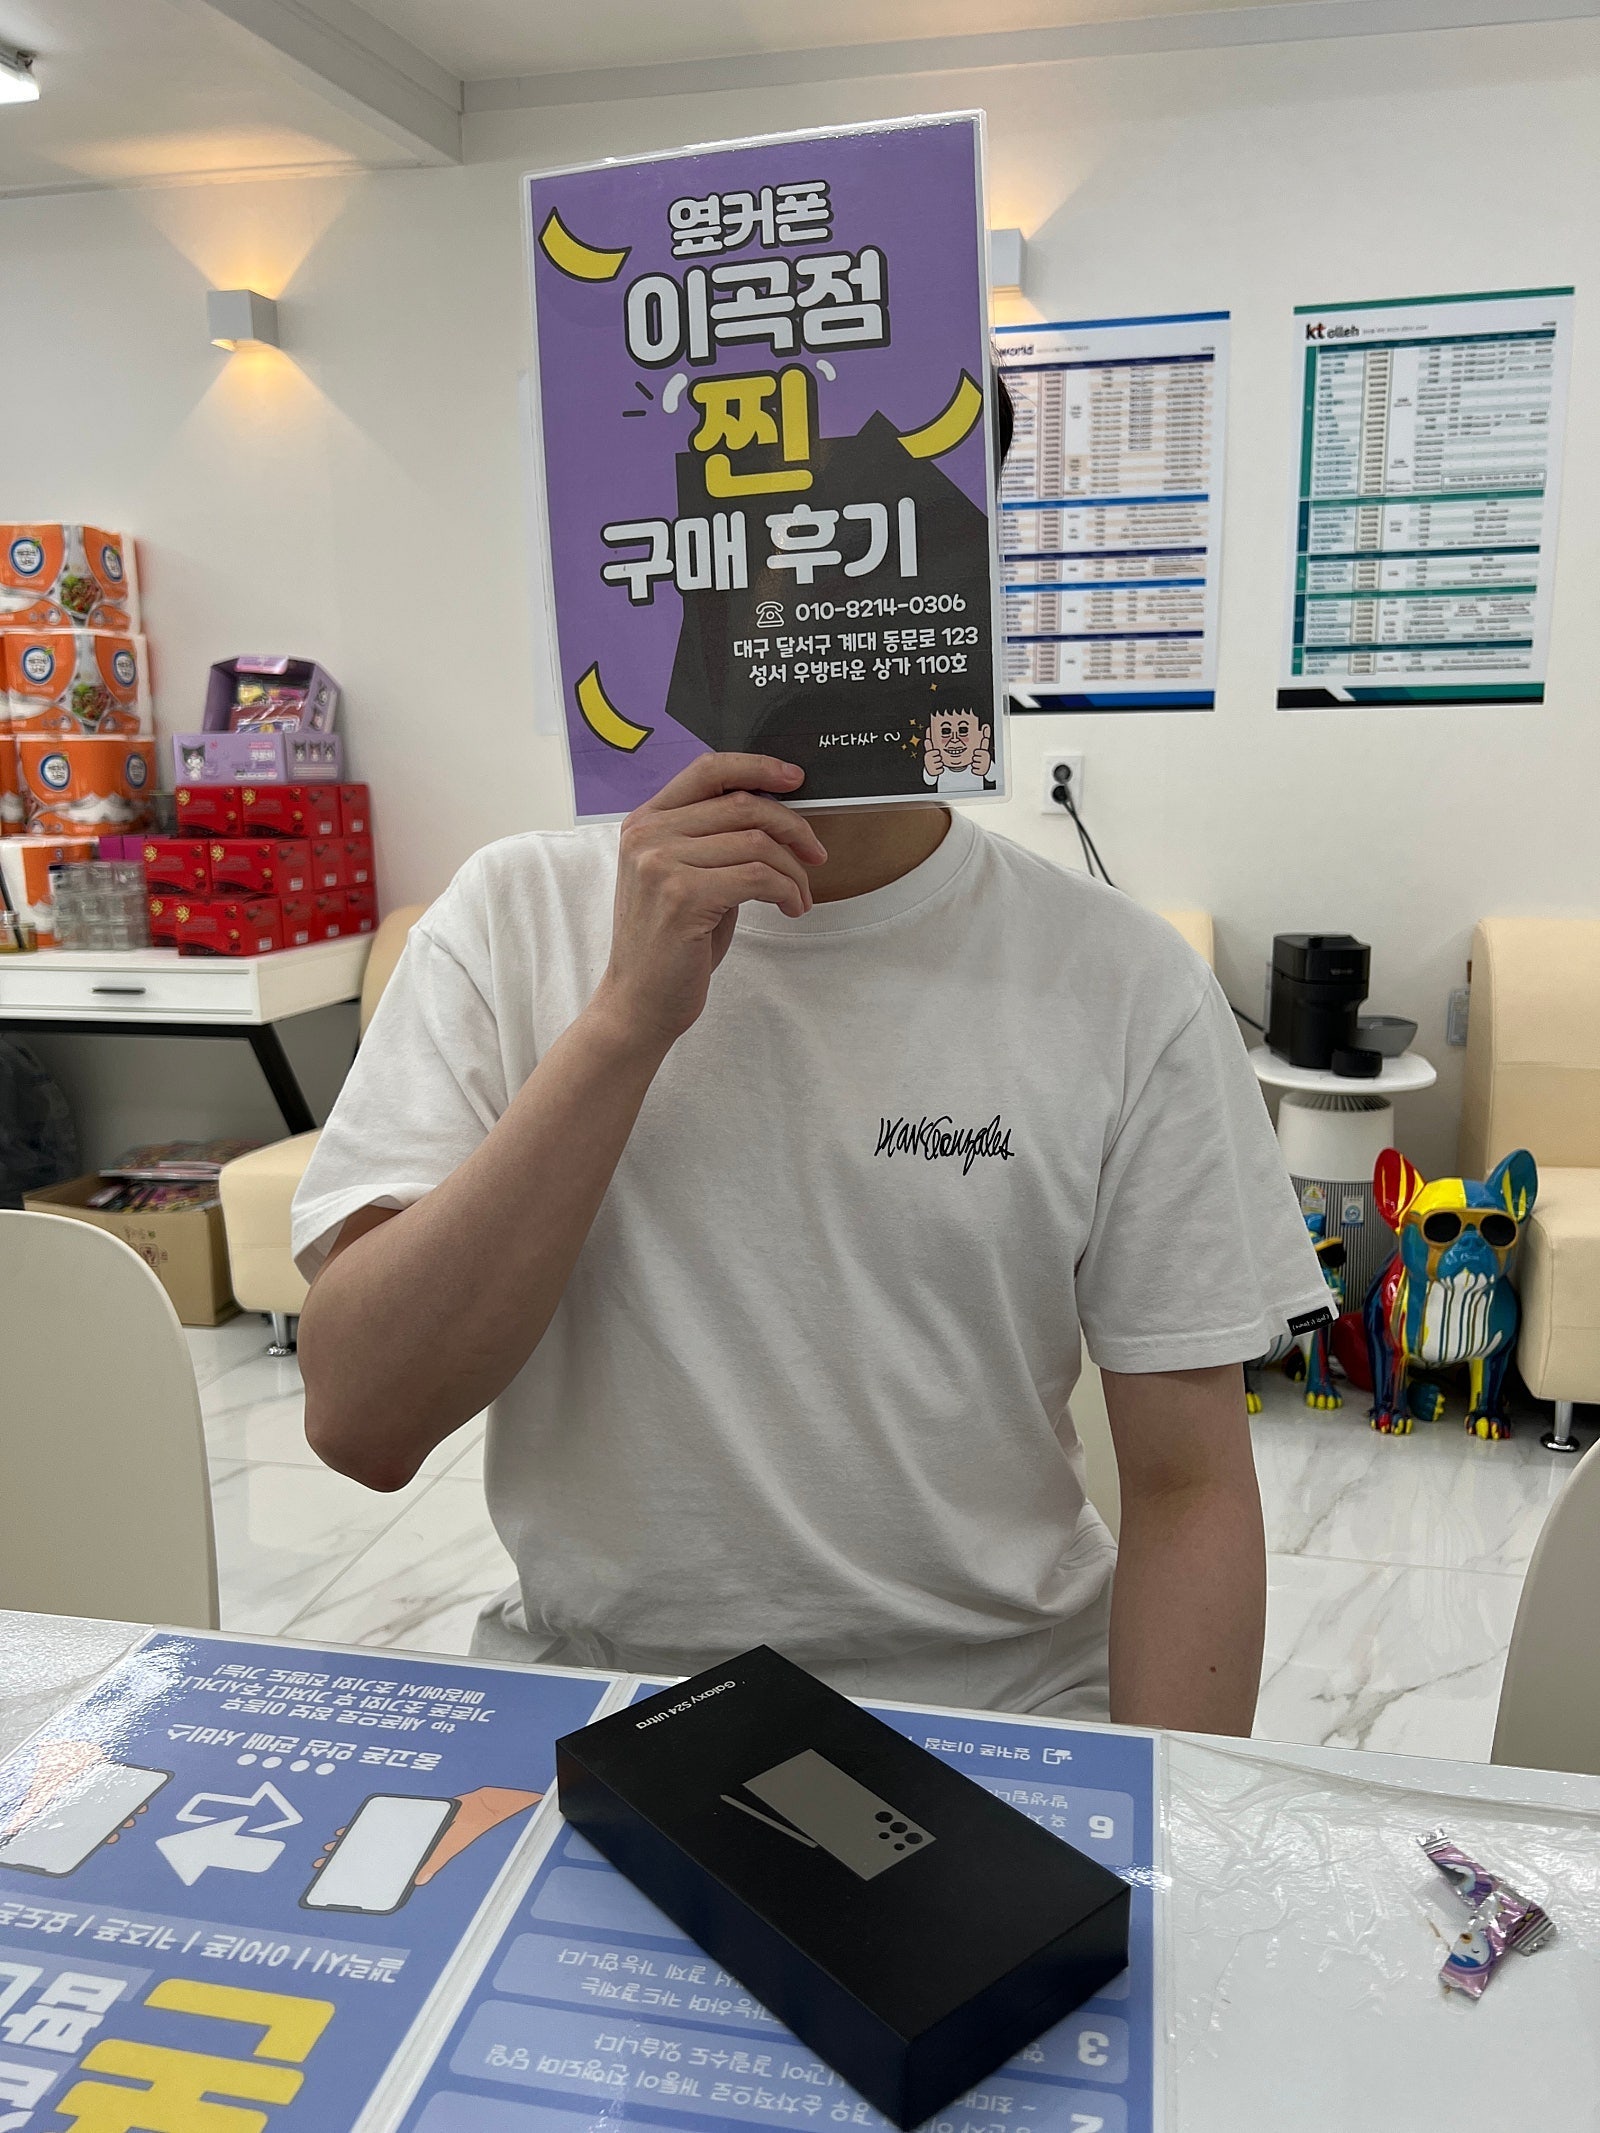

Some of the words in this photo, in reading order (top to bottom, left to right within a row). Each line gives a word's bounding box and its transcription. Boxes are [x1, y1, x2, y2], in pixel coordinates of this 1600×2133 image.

[669, 181, 830, 258] 옆커폰
[626, 249, 885, 363] 이곡점
[1306, 322, 1326, 340] kt
[1327, 325, 1360, 339] olleh
[692, 368, 814, 500] 찐
[602, 510, 749, 601] 구매
[765, 497, 919, 586] 후기
[794, 593, 967, 622] 010-8214-0306
[733, 638, 771, 660] 대구
[775, 634, 832, 657] 달서구
[837, 631, 877, 654] 계대
[882, 630, 937, 655] 동문로
[941, 627, 979, 646] 123
[749, 665, 788, 688] 성서
[793, 659, 867, 685] 우방타운
[872, 657, 911, 680] 상가
[915, 651, 968, 676] 110호
[212, 1662, 265, 1679] 가능!
[264, 1667, 330, 1687] 진행도
[180, 1674, 264, 1696] 주시거나
[263, 1683, 327, 1704] 가져다
[331, 1674, 398, 1694] 초기화
[398, 1681, 485, 1703] 매장에서
[690, 1680, 736, 1704] Galaxy
[219, 1696, 286, 1716] 이동후
[334, 1691, 353, 1707] 후
[357, 1693, 426, 1713] 초기화
[668, 1700, 692, 1715] S24
[287, 1702, 330, 1721] 정보
[335, 1708, 426, 1731] 새폰으로
[426, 1701, 496, 1722] 기존폰
[635, 1711, 670, 1730] Ultra
[166, 1721, 246, 1745] 서비스
[430, 1719, 455, 1733] tip
[241, 1730, 299, 1753] 판매
[299, 1737, 357, 1760] 안심
[923, 1735, 974, 1754] 이곡점
[978, 1741, 1030, 1760] 옆커폰
[357, 1744, 442, 1771] 중고폰
[987, 1788, 1068, 1809] 발생됩니
[1087, 1813, 1114, 1839] 6
[91, 1915, 177, 1951] 키즈폰
[199, 1932, 290, 1967] 아이폰
[555, 1946, 657, 1977] 가능합니다
[310, 1947, 405, 1984] 갤럭시
[662, 1962, 706, 1984] 결제
[579, 1975, 681, 2007] 카드결제는
[483, 2041, 529, 2070] 당일
[592, 2031, 681, 2062] 있습니다
[1076, 2029, 1109, 2066] 3
[534, 2054, 630, 2088] 진행되며
[687, 2045, 772, 2077] 걸릴수도
[633, 2068, 700, 2097] 개통이
[707, 2080, 823, 2116] 순차적으로
[829, 2098, 872, 2125] 경우
